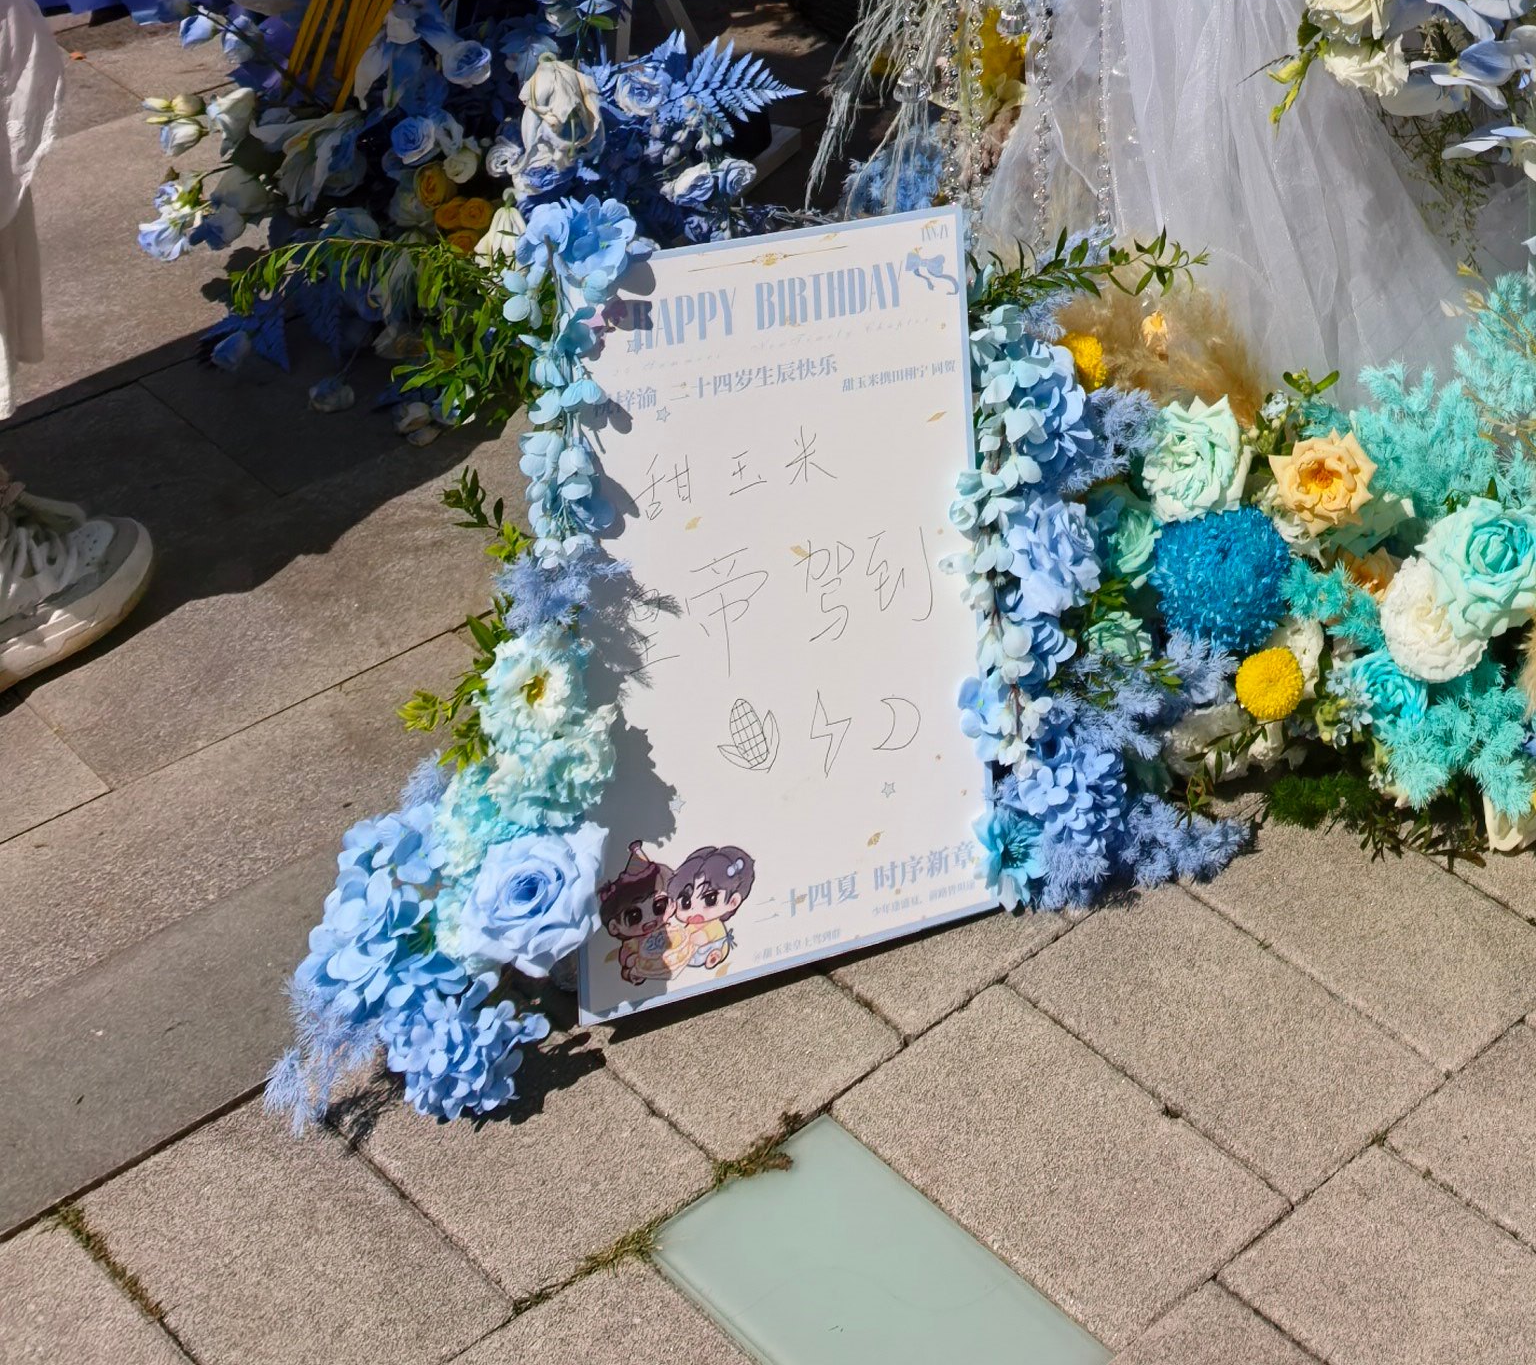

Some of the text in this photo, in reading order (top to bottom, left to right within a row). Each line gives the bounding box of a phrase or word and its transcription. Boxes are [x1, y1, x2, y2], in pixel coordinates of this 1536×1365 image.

[630, 260, 906, 351] HAPPY BIRTHDAY
[668, 353, 838, 402] 二十四岁生辰快乐
[753, 839, 974, 924] 二十四夏 时序新章
